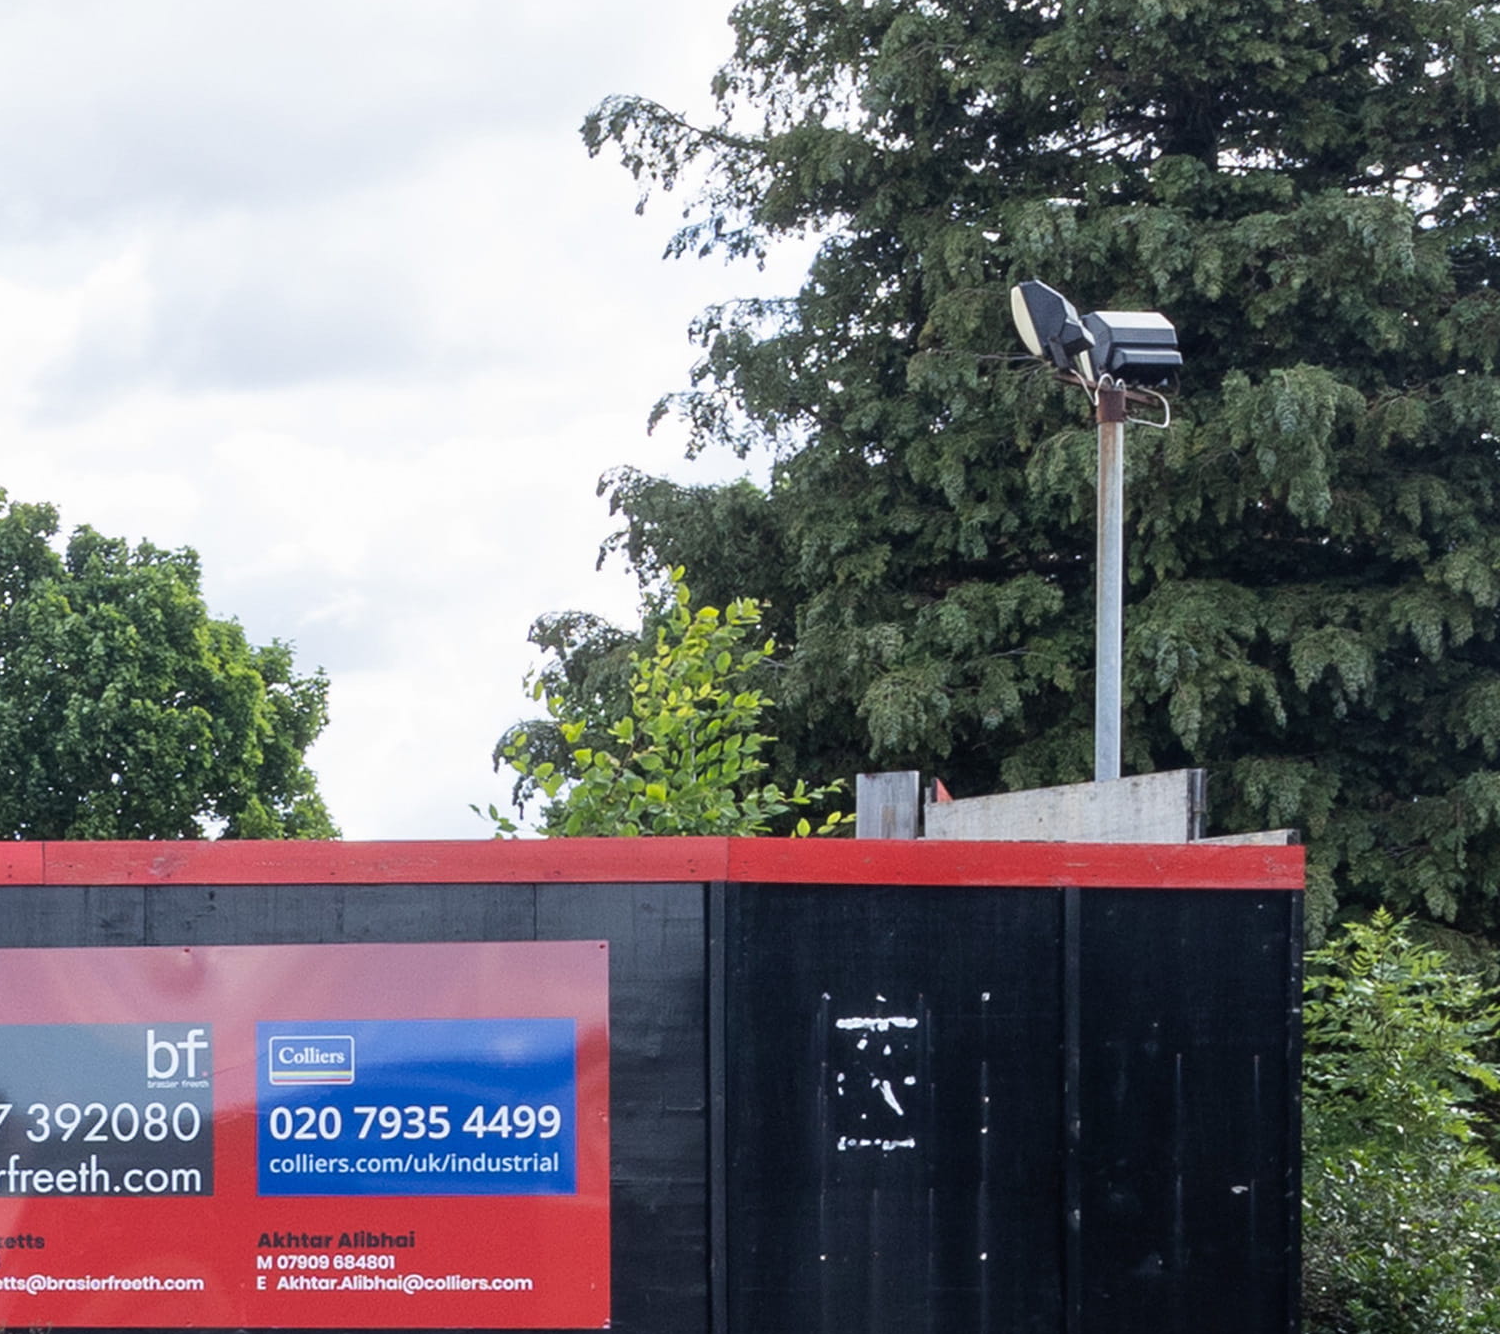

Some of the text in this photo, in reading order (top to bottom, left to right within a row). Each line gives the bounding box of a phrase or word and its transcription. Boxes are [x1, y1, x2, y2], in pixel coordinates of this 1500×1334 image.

[278, 1047, 345, 1064] Colliers
[25, 1102, 201, 1143] 392080
[269, 1105, 562, 1140] 020 7935 4499
[269, 1153, 559, 1173] colliers.com/uk/industrial
[258, 1231, 416, 1249] Akhtar Alibhai
[257, 1255, 396, 1270] M 07909 684801
[257, 1273, 534, 1295] E Akhtar.Alibhai@colliers.com
